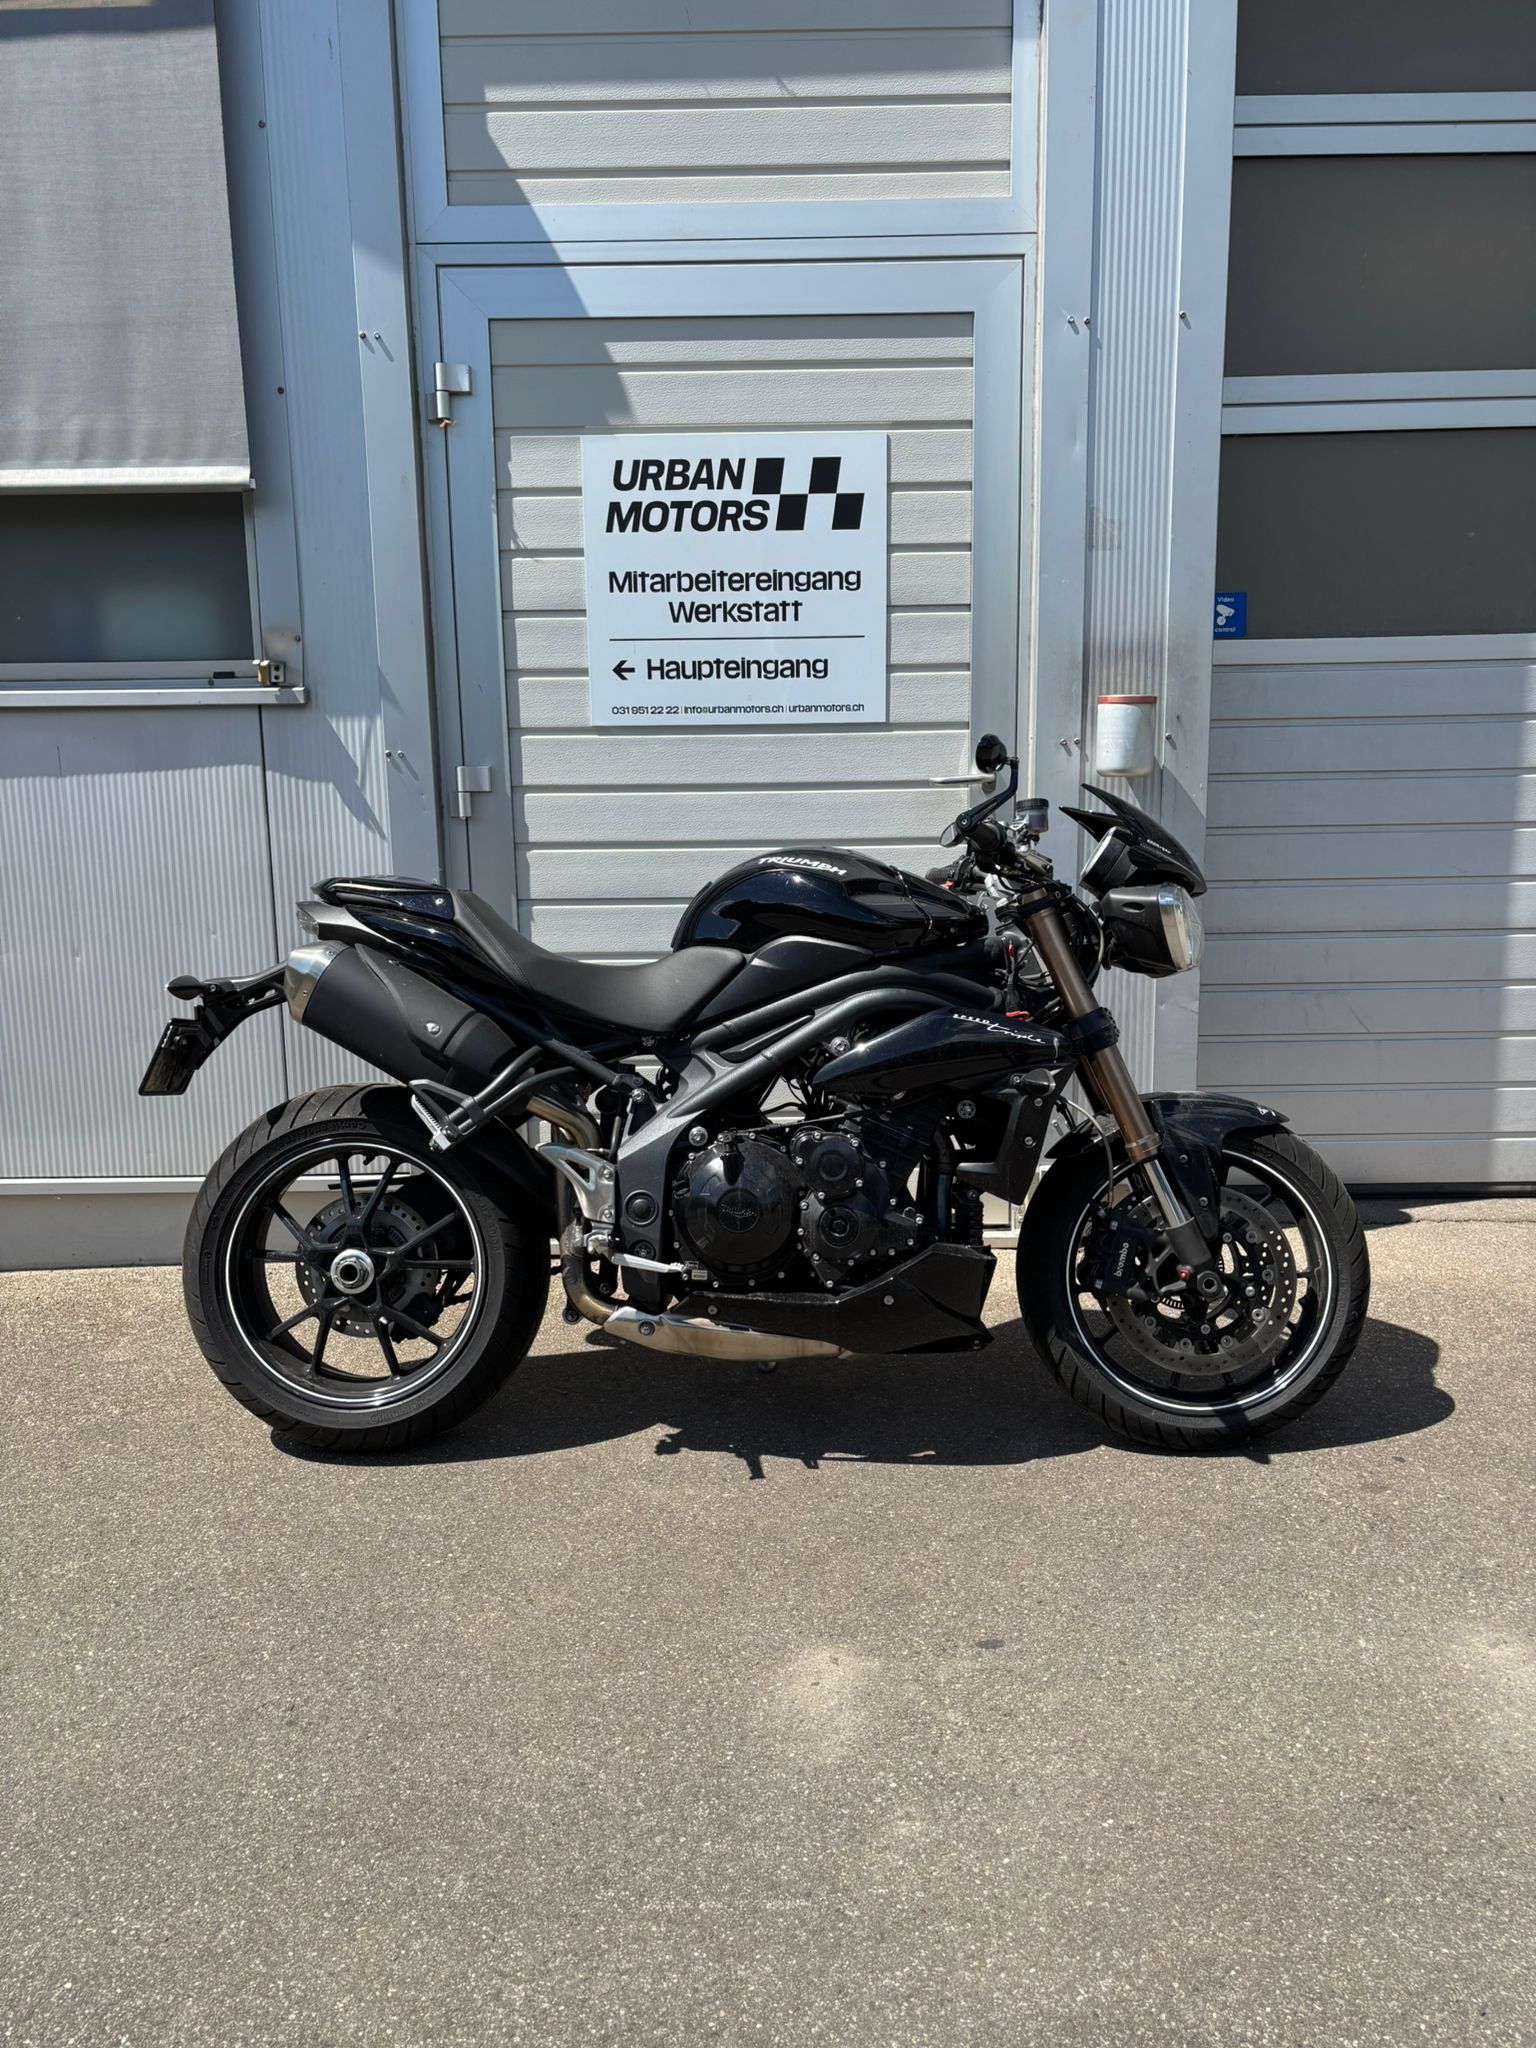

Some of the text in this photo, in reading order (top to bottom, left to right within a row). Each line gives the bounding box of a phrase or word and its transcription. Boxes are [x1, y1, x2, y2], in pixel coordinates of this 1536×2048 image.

[612, 457, 747, 492] URBAN
[605, 499, 771, 534] MOTORS
[608, 568, 862, 594] Mitarbeitereingang
[668, 599, 803, 624] Werkstatt
[646, 656, 829, 681] Haupteingang
[649, 705, 664, 715] 22
[665, 705, 680, 715] 22
[788, 703, 865, 714] urbanmotors.ch
[758, 856, 848, 876] TRIUMPH
[1113, 1242, 1129, 1277] brembo
